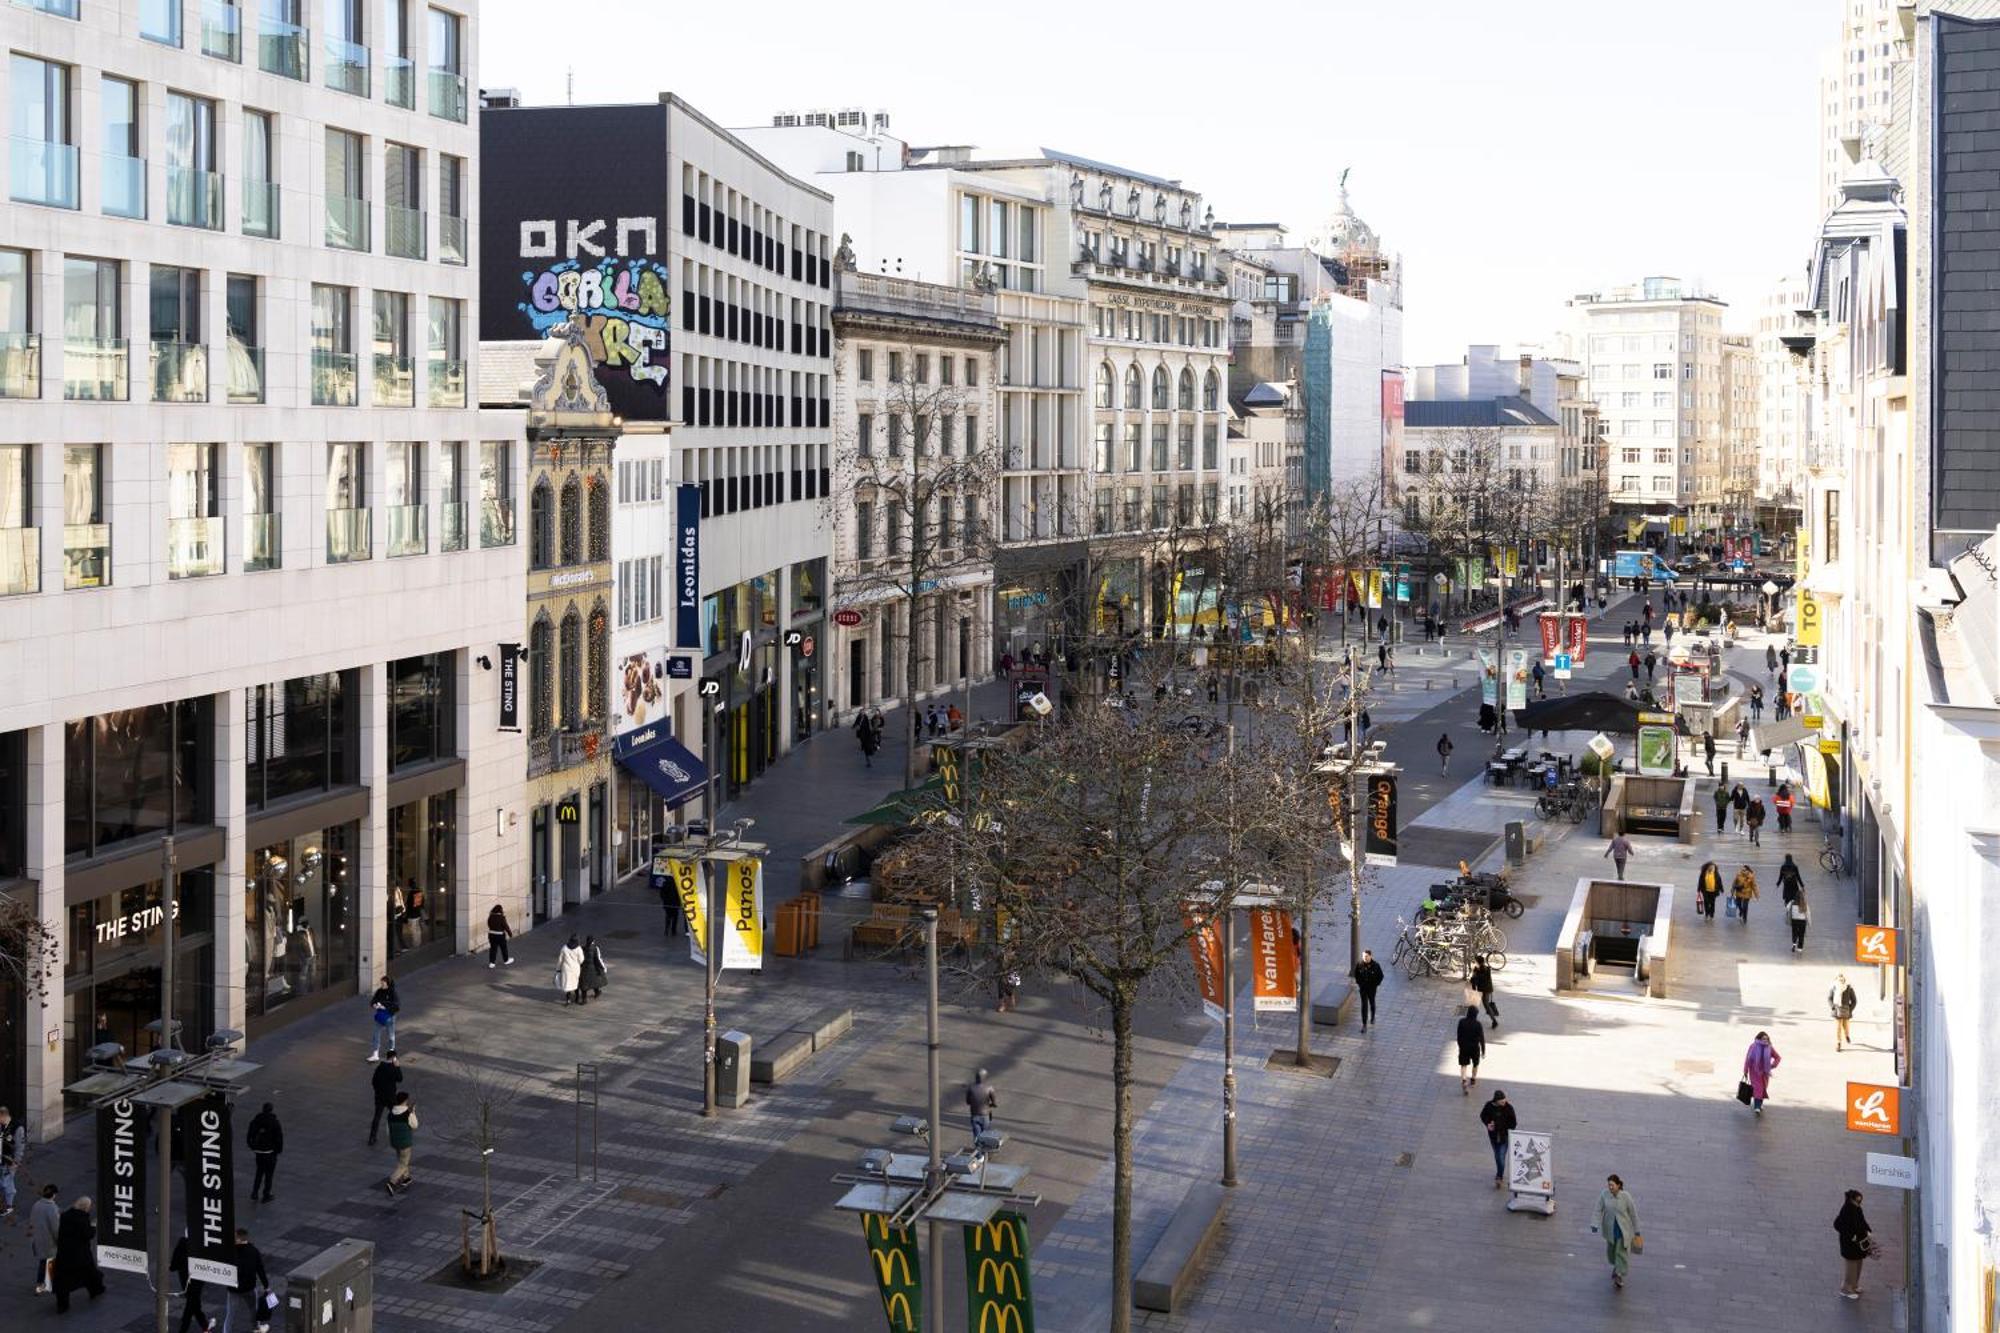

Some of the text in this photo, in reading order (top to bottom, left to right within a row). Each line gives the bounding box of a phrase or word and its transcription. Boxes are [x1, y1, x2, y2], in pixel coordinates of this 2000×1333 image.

[681, 527, 696, 607] Leonidas
[786, 633, 801, 644] JD
[504, 658, 513, 712] THE STING
[701, 682, 719, 694] JD
[1374, 781, 1391, 840] Orange
[95, 900, 179, 943] THE STING
[679, 866, 698, 933] anos
[736, 865, 752, 931] Panos
[114, 1098, 134, 1234] THE STING
[201, 1110, 222, 1247] THE STING
[1871, 1165, 1912, 1179] Bershka
